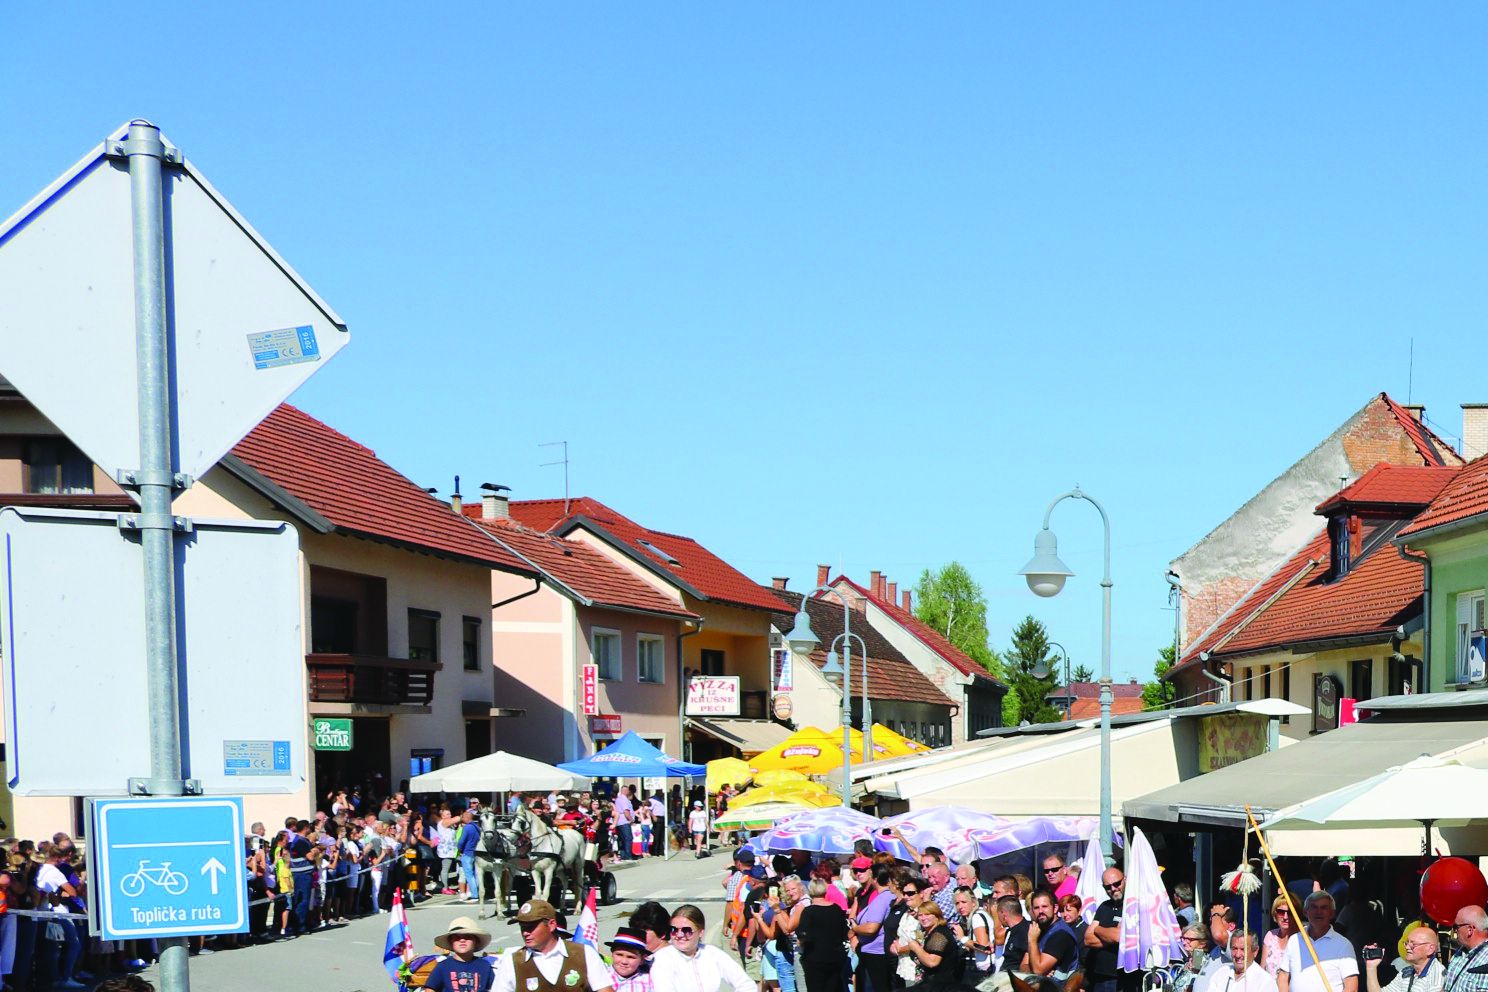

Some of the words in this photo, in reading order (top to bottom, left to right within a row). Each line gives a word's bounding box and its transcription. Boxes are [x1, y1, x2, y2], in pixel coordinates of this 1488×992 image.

[302, 331, 313, 351] 2016
[688, 679, 736, 693] PIZZA
[316, 734, 350, 747] CENTAR
[277, 746, 285, 764] 2016
[130, 905, 187, 927] Toplička
[191, 904, 221, 920] ruta
